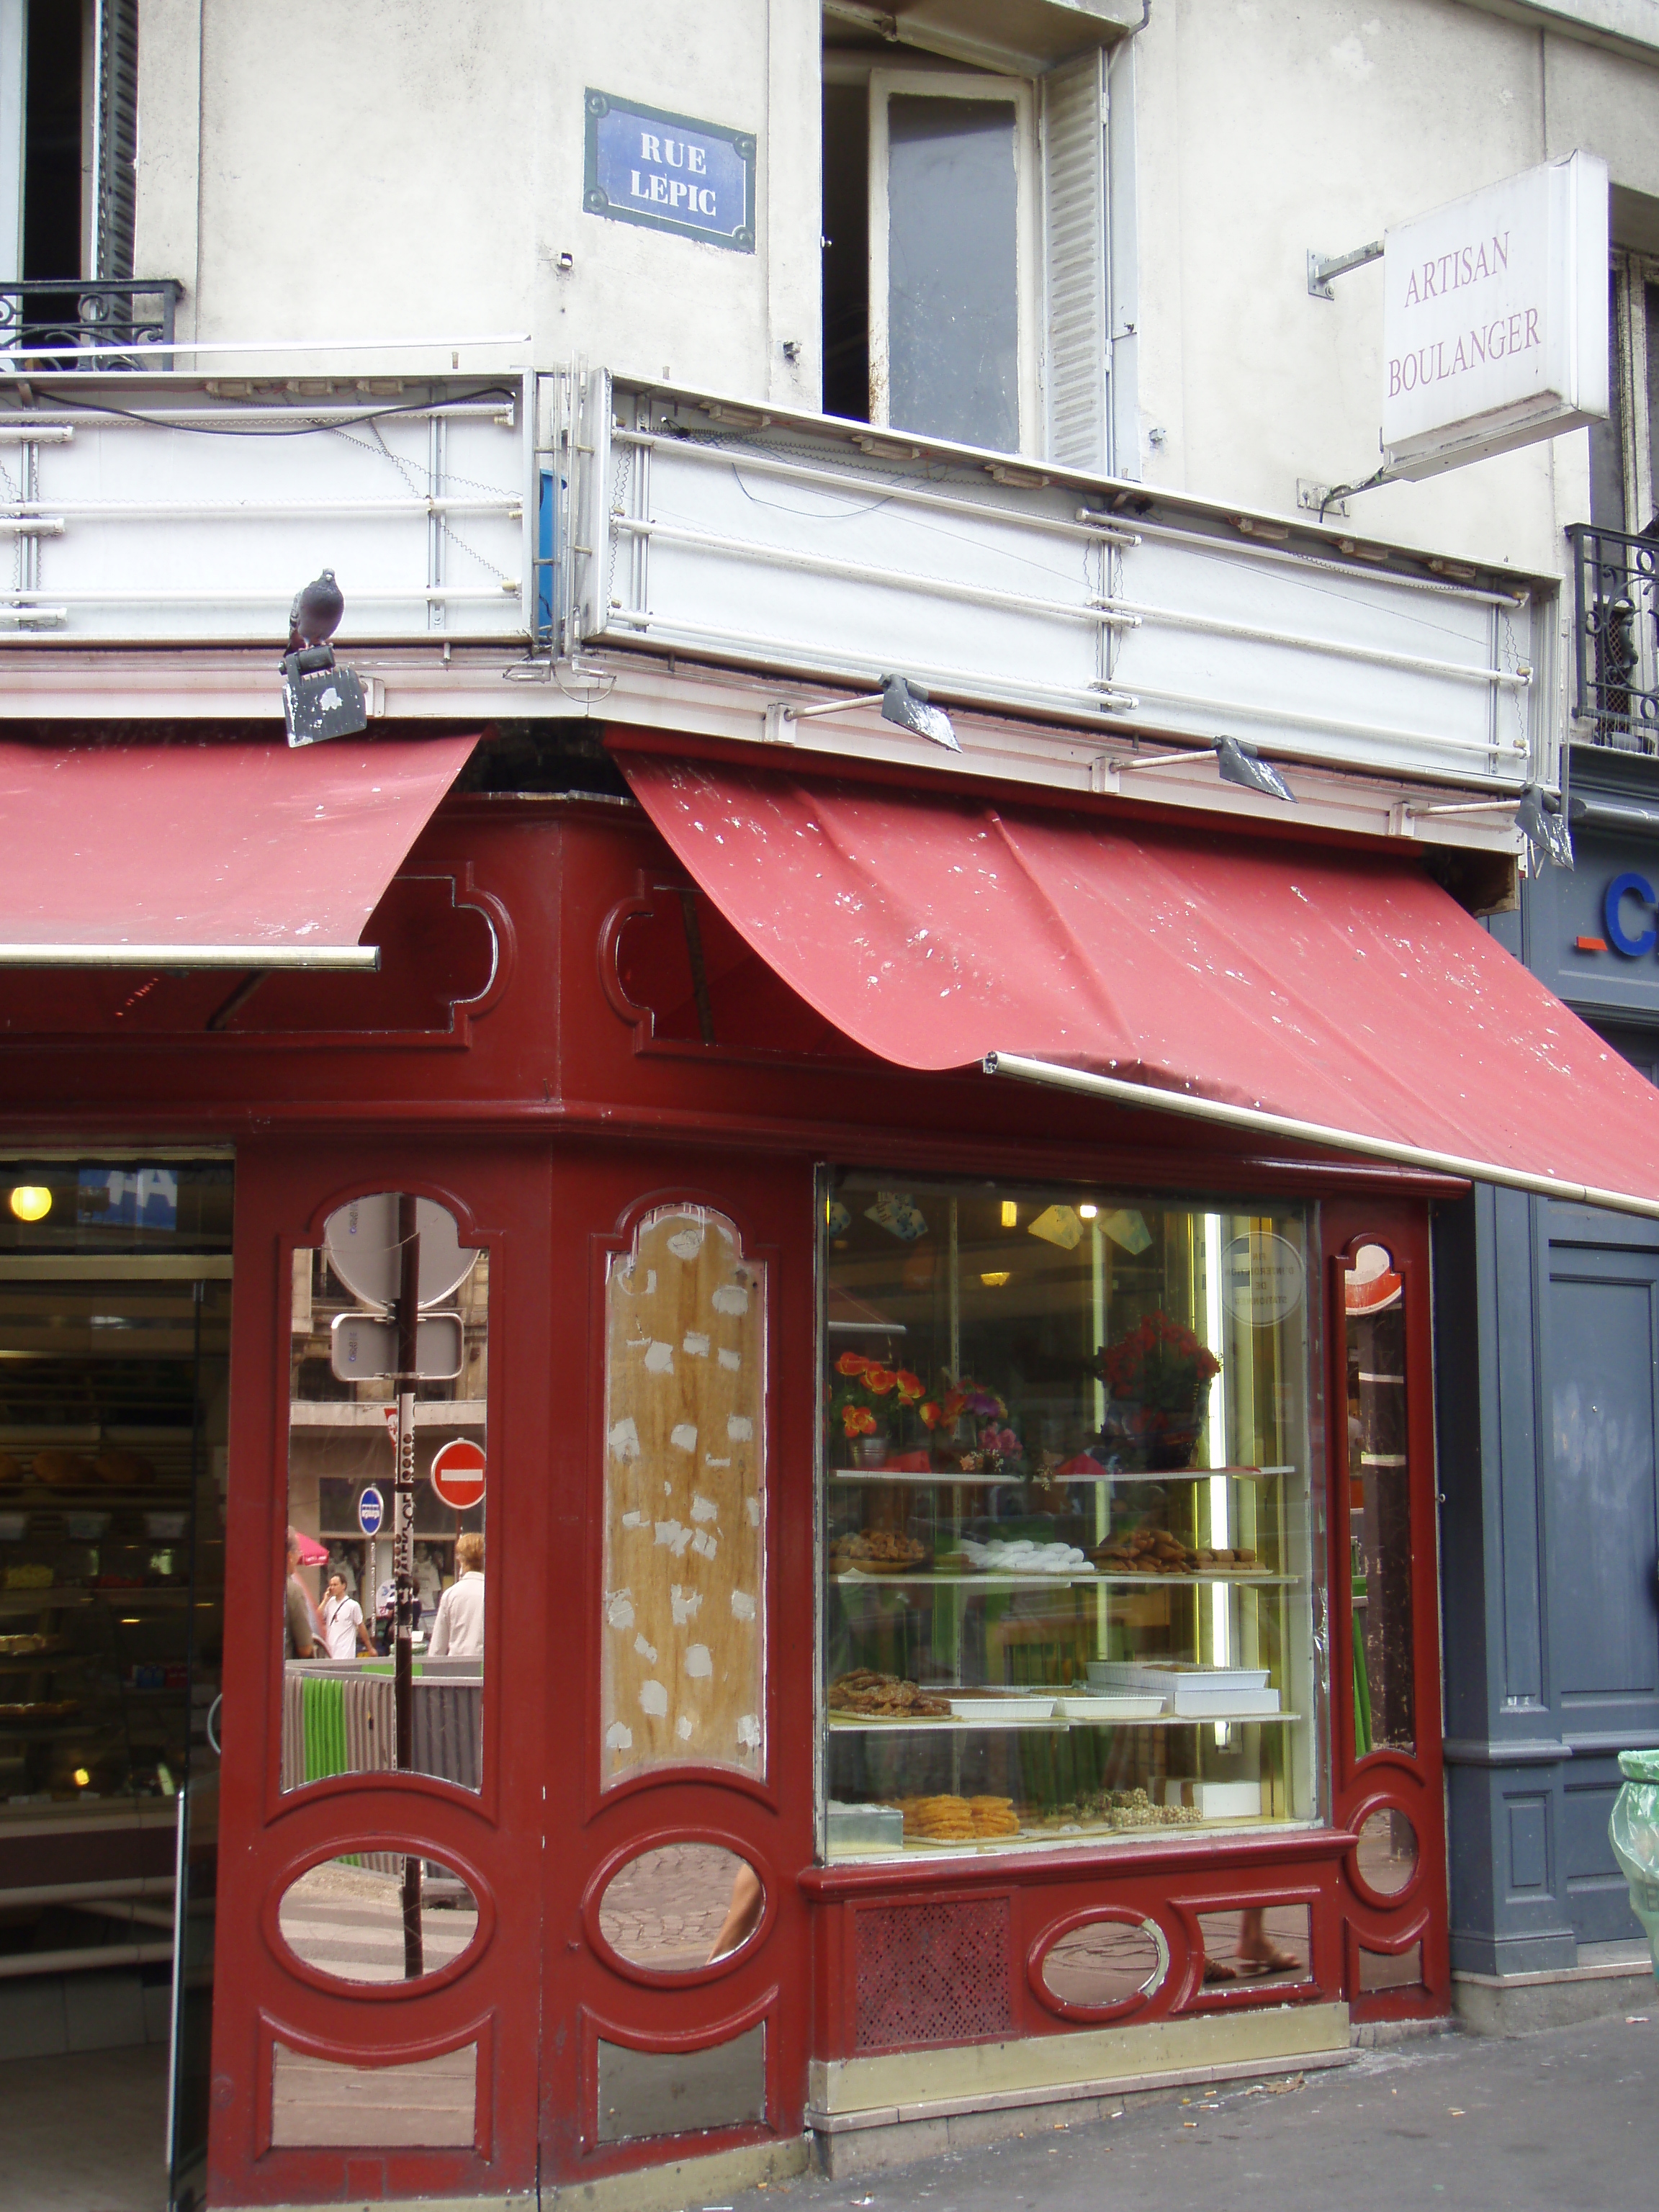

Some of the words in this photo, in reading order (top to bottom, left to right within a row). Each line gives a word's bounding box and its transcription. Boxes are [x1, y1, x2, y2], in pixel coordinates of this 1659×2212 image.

[641, 132, 706, 175] RUE
[630, 170, 716, 217] LEPIC
[1404, 231, 1511, 308] ARTISAN
[1388, 308, 1542, 398] BOULANGER
